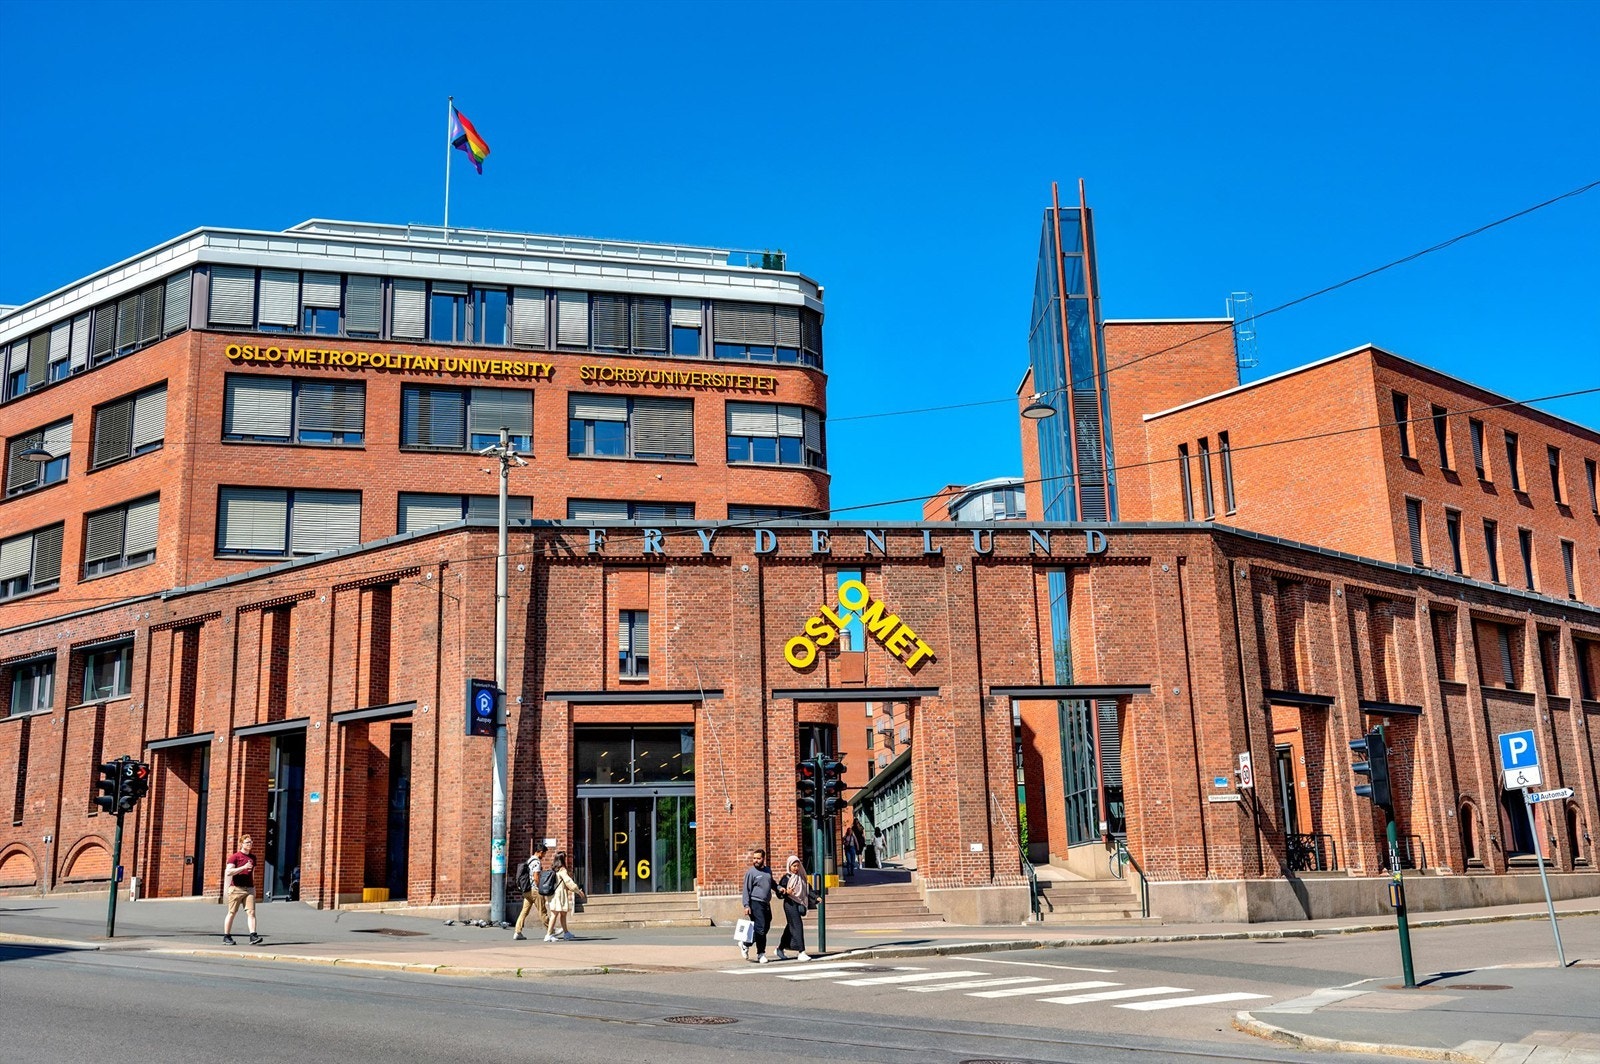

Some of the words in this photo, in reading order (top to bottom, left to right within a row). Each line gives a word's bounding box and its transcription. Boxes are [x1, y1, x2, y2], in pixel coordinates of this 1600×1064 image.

[224, 344, 281, 362] OSLO
[287, 347, 439, 371] METROPOLITAN
[445, 357, 554, 377] UNIVERSITY
[579, 365, 777, 389] STORBYUNIVERSITETET
[587, 528, 1108, 555] FRYDENLUND
[1509, 737, 1528, 765] P
[1540, 790, 1568, 800] Automat
[614, 831, 628, 852] P
